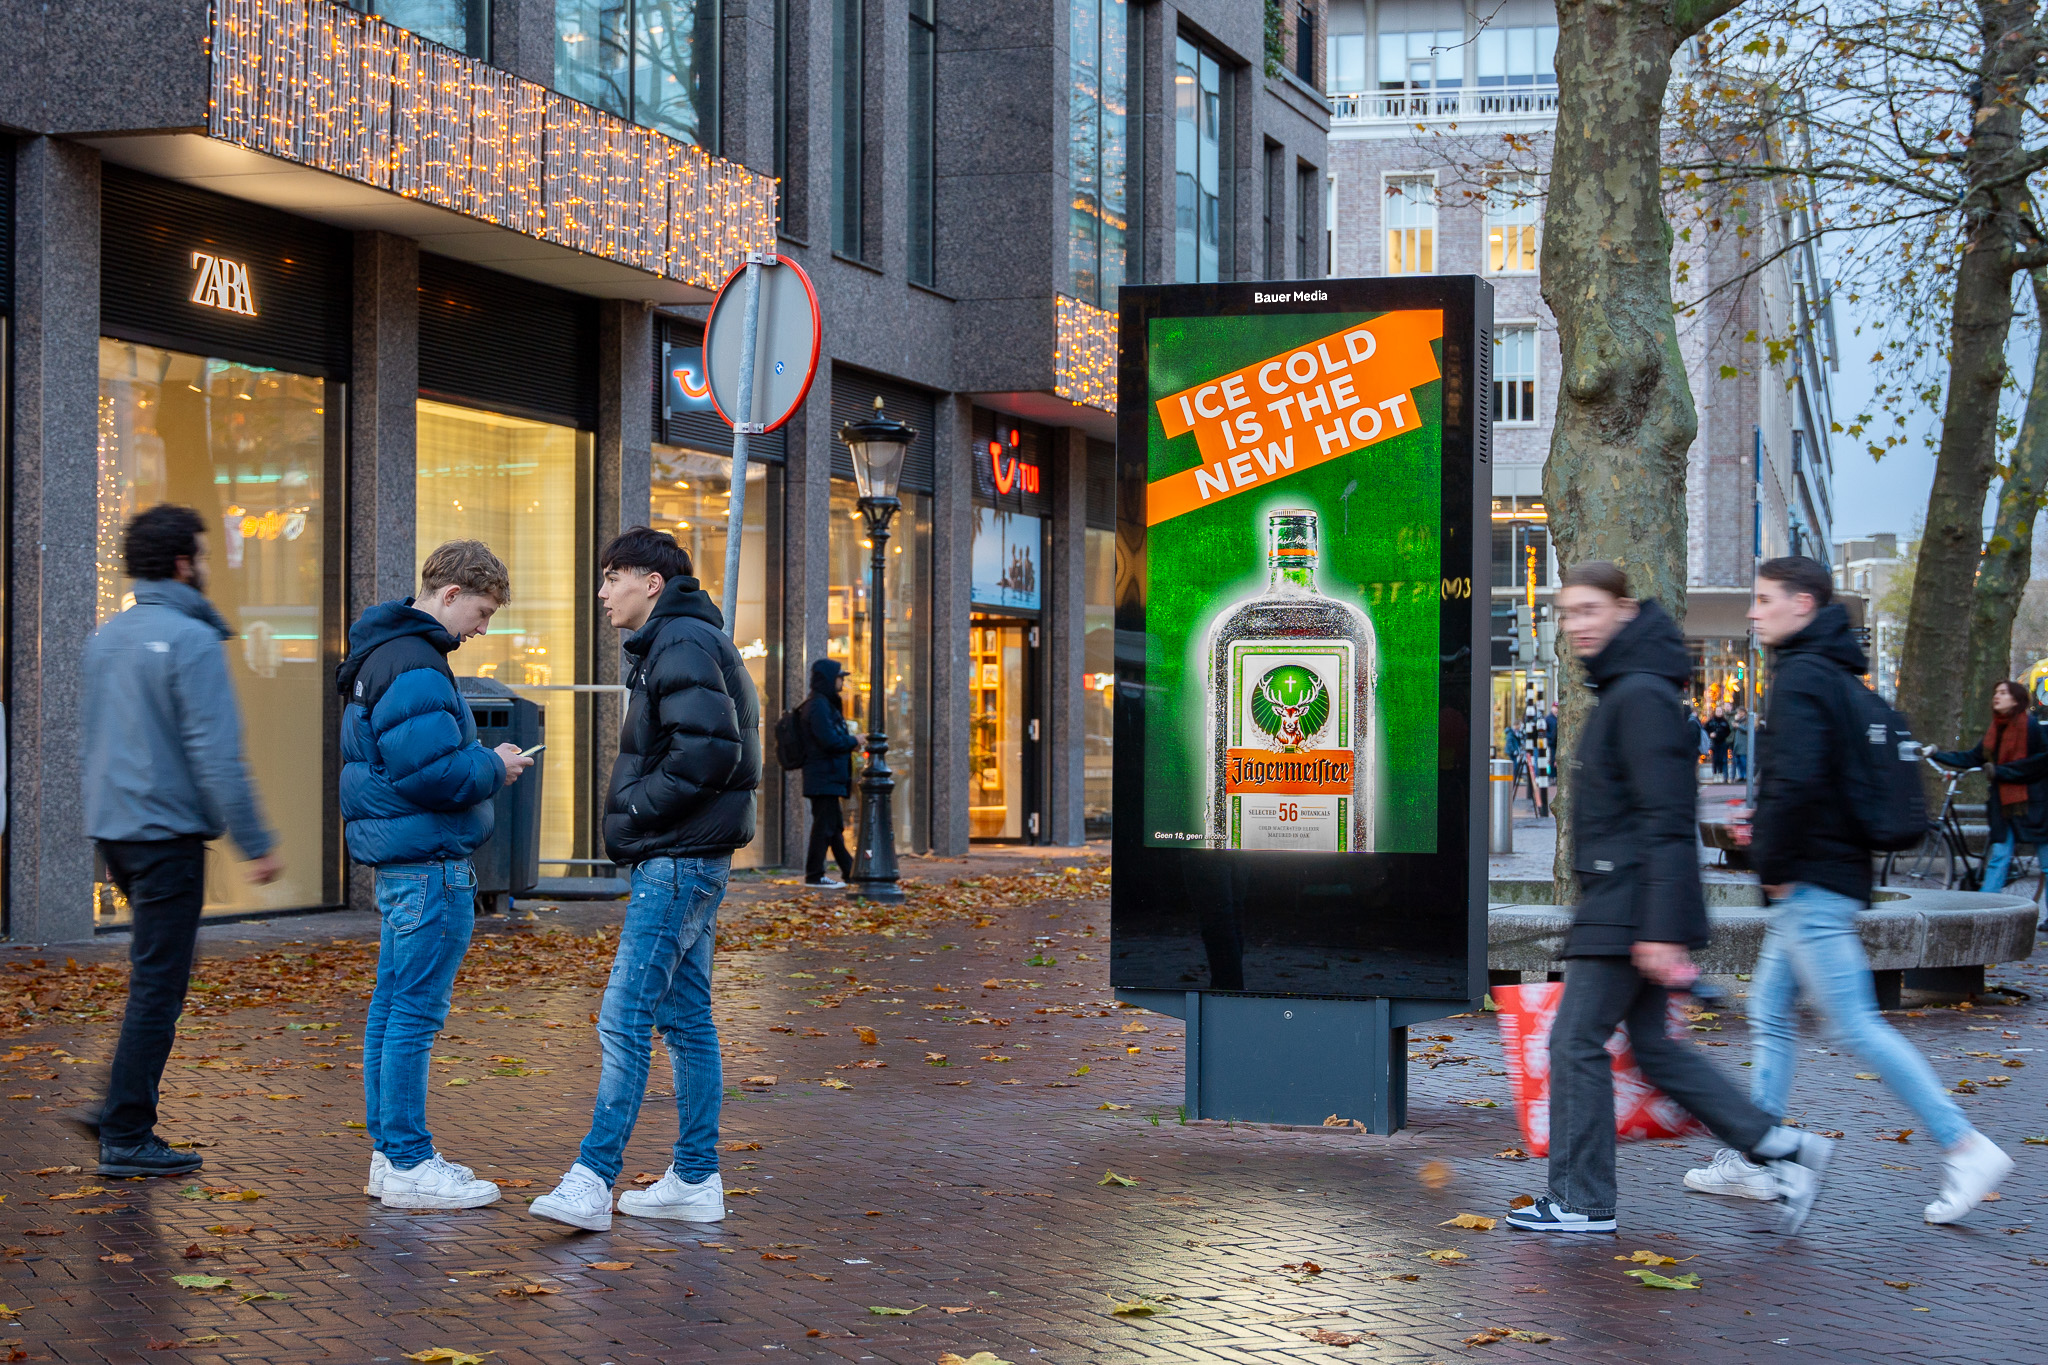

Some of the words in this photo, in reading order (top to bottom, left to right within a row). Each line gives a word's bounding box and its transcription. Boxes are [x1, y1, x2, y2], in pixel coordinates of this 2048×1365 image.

[192, 252, 257, 316] ZARA
[1254, 291, 1291, 303] Bauer
[1293, 289, 1328, 302] Media
[1178, 374, 1251, 427] ICE
[1257, 329, 1377, 395] COLD
[1220, 410, 1264, 451] IS
[1266, 373, 1361, 431] THE
[1193, 435, 1295, 500] NEW
[1314, 393, 1408, 456] HOT
[1018, 462, 1039, 494] TUI
[1154, 831, 1173, 839] Geen
[1174, 832, 1185, 840] 18,
[1186, 833, 1203, 841] geen
[1278, 802, 1298, 822] 56
[1300, 809, 1331, 817] BOTANICALS
